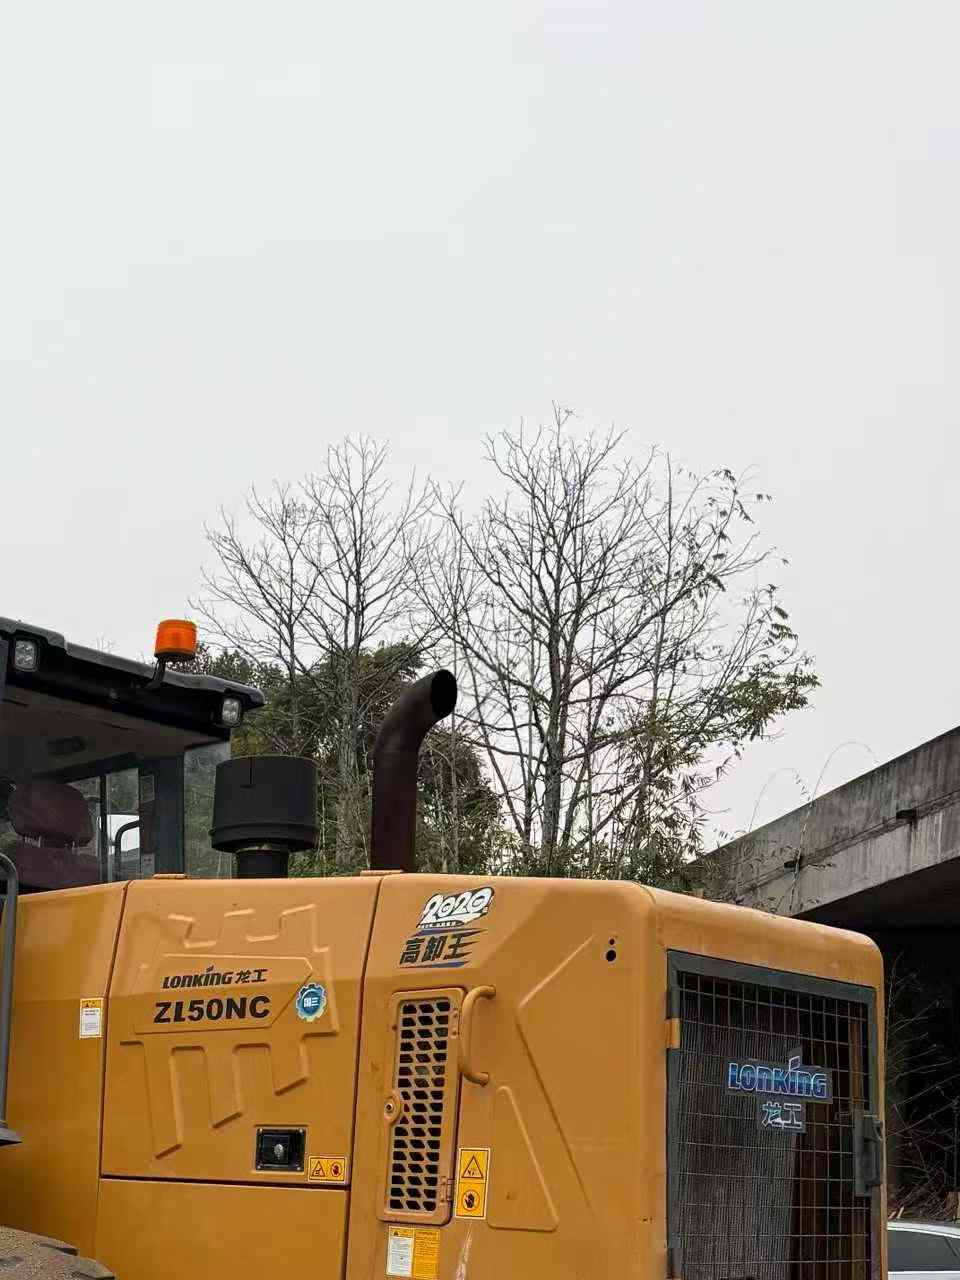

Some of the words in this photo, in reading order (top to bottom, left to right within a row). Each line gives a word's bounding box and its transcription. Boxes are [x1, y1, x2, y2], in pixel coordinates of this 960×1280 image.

[419, 886, 494, 922] 2020
[400, 934, 476, 965] 高卸王
[235, 968, 268, 984] 龙工
[153, 995, 271, 1024] ZL50NC
[761, 1101, 803, 1130] 龙工
